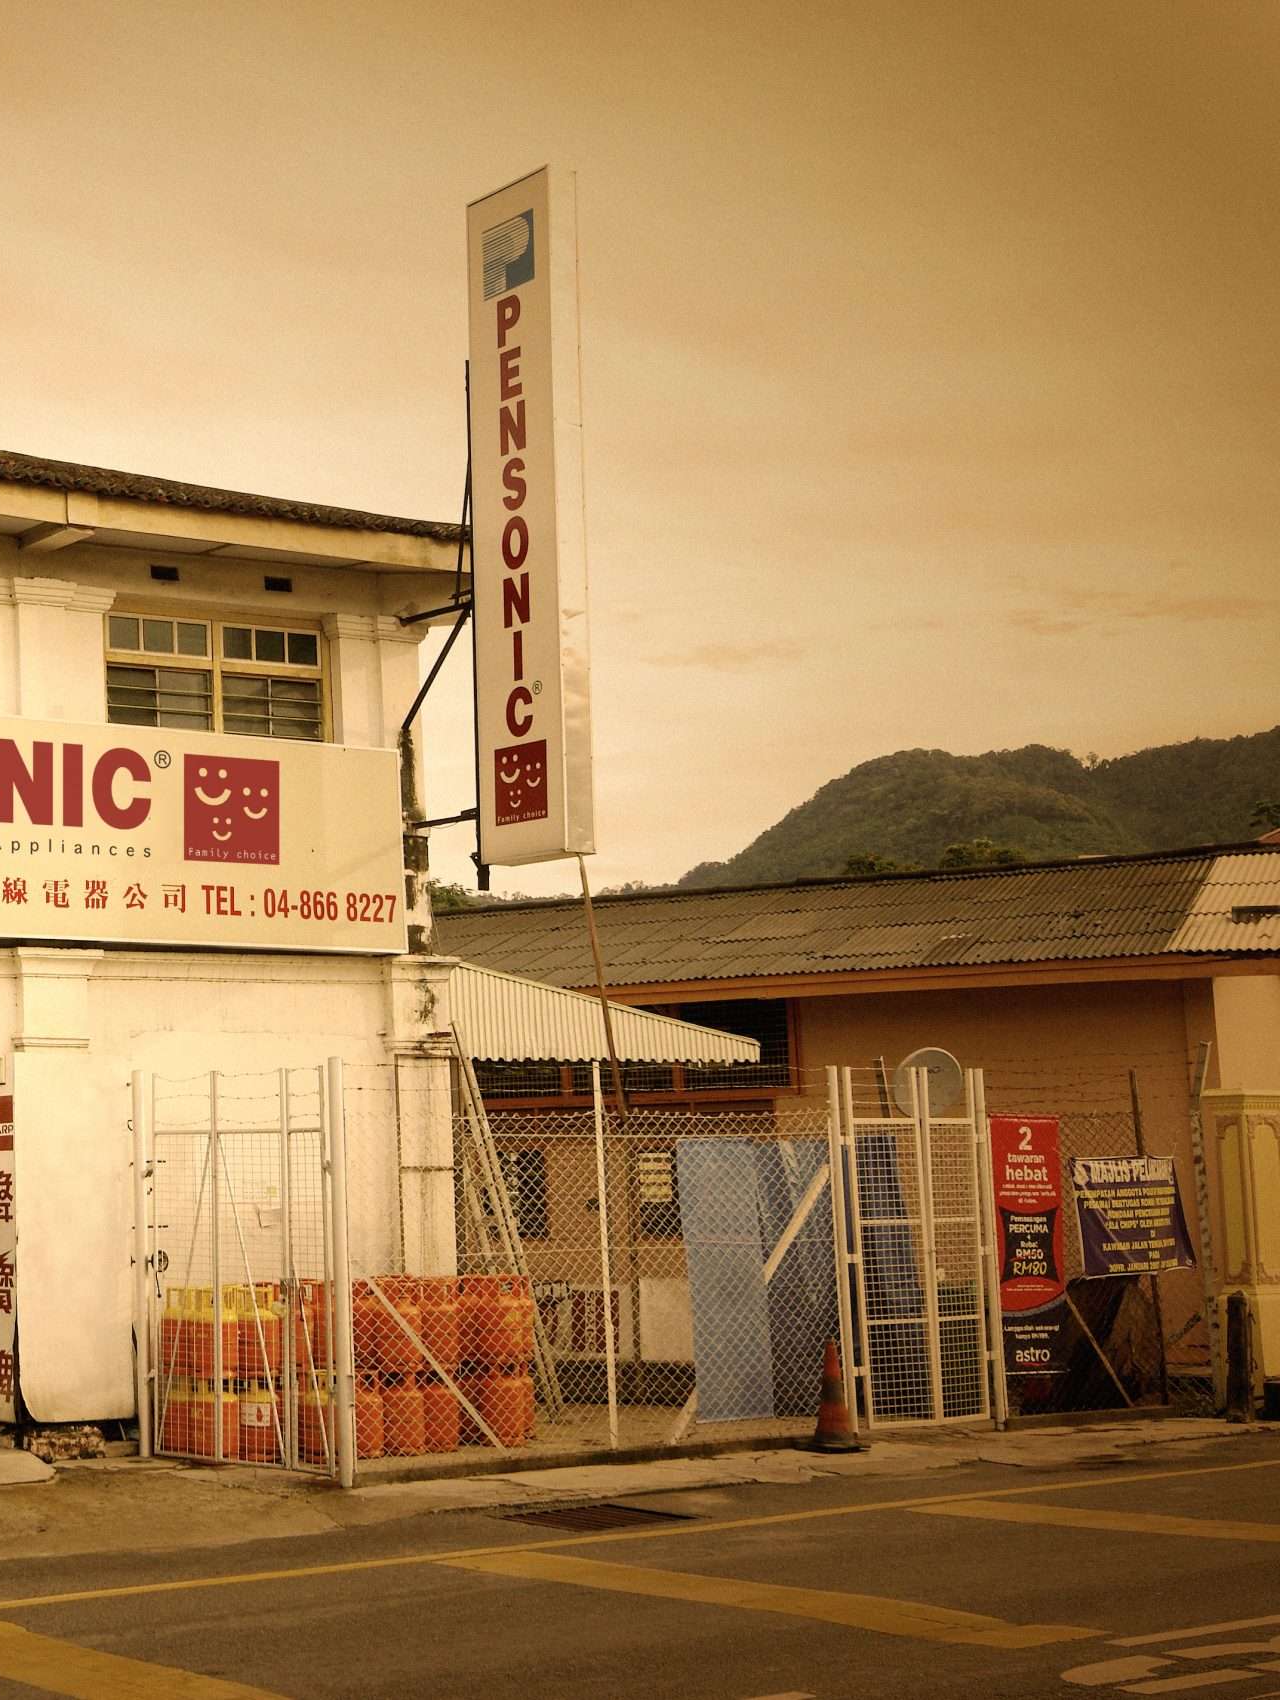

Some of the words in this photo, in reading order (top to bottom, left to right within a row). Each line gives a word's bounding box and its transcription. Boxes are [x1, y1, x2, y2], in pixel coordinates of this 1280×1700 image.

[496, 294, 534, 738] PENSONIC
[236, 850, 277, 861] choice
[263, 888, 339, 922] 04-866
[346, 893, 398, 924] 8227
[1018, 1126, 1033, 1151] 2
[1007, 1152, 1045, 1164] tawaran
[1005, 1164, 1049, 1182] hebat
[1008, 1223, 1049, 1233] PERCUMA
[1015, 1248, 1044, 1260] RM50
[1013, 1260, 1048, 1276] RM80
[1015, 1346, 1050, 1363] astro
